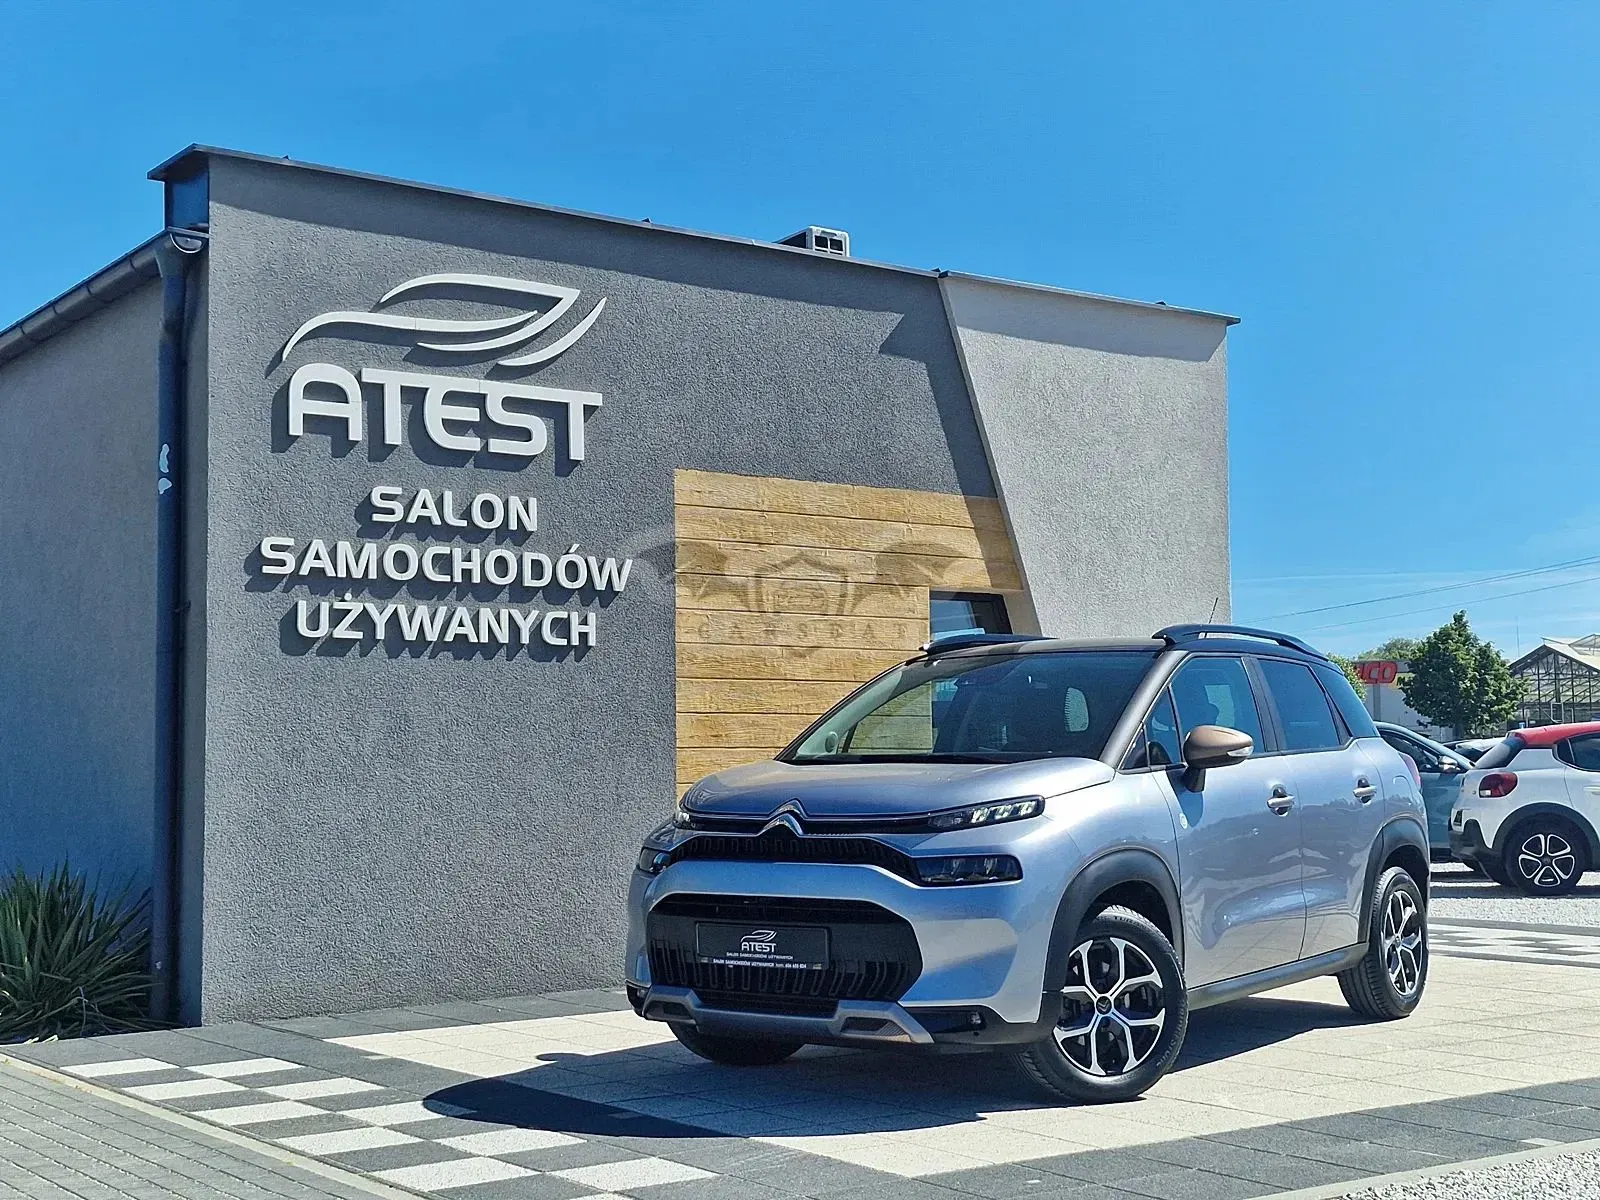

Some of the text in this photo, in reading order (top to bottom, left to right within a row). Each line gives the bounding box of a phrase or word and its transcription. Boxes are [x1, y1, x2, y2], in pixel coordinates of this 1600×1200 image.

[288, 363, 603, 461] ATEST
[371, 485, 538, 532] SALON
[260, 536, 634, 592] SAMOCHODÓW
[295, 593, 598, 647] UŻYWANYCH
[741, 941, 777, 953] ATEST
